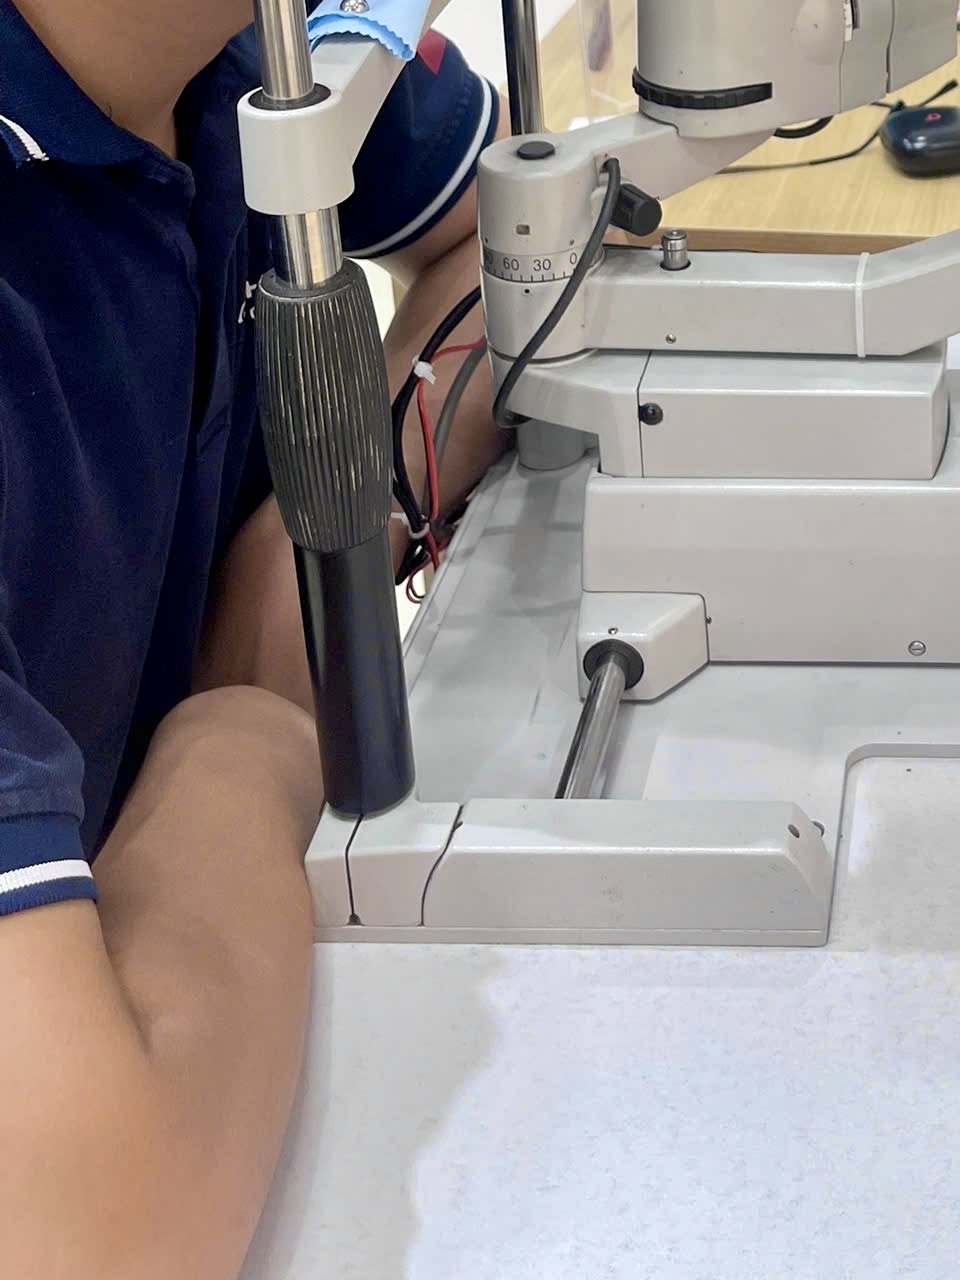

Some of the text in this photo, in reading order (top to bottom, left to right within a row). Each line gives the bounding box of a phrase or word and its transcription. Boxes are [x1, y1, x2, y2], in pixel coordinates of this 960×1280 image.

[503, 257, 520, 271] 60
[533, 258, 552, 271] 30
[569, 252, 578, 264] 0
